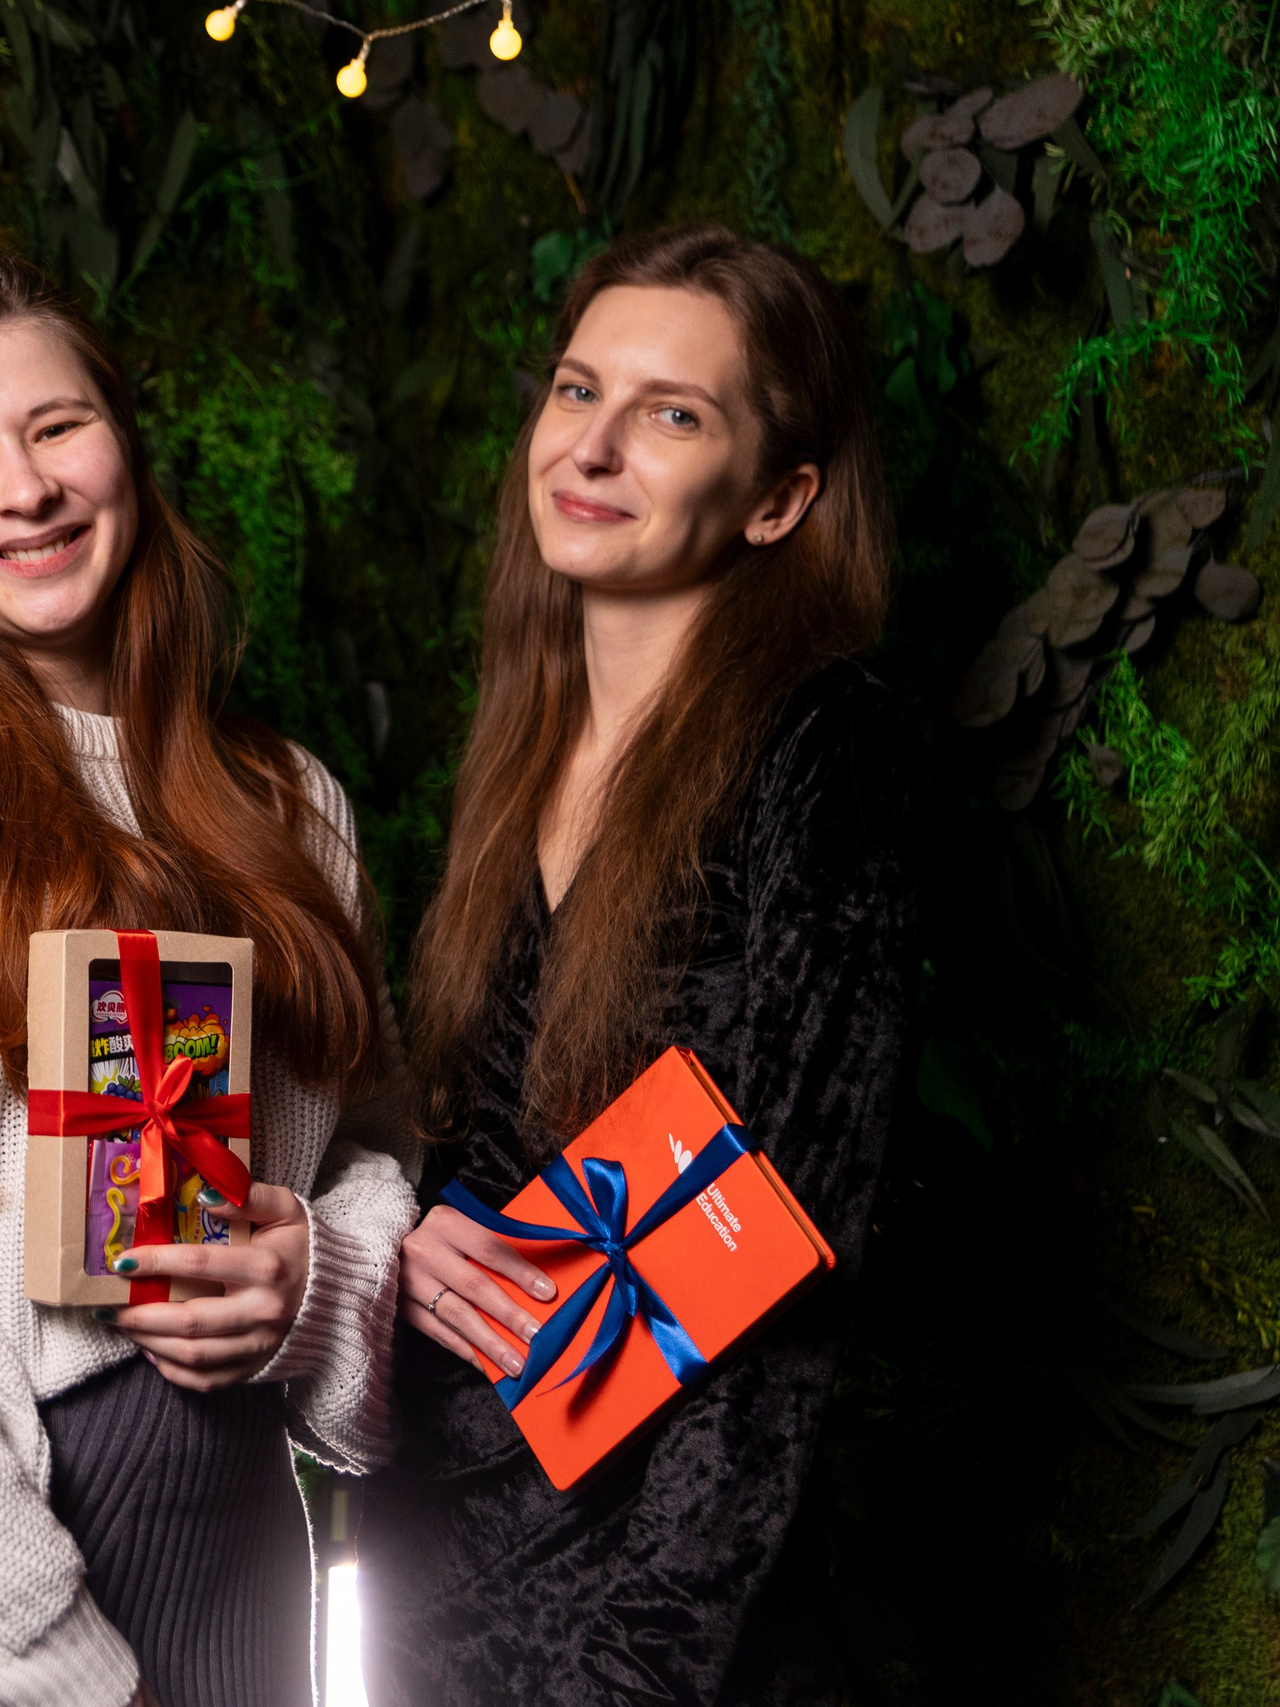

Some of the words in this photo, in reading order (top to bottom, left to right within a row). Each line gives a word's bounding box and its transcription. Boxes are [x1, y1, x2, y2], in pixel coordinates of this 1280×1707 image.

[164, 1034, 218, 1064] BOOM!
[695, 1192, 737, 1251] Education
[706, 1182, 741, 1232] Ultimate
